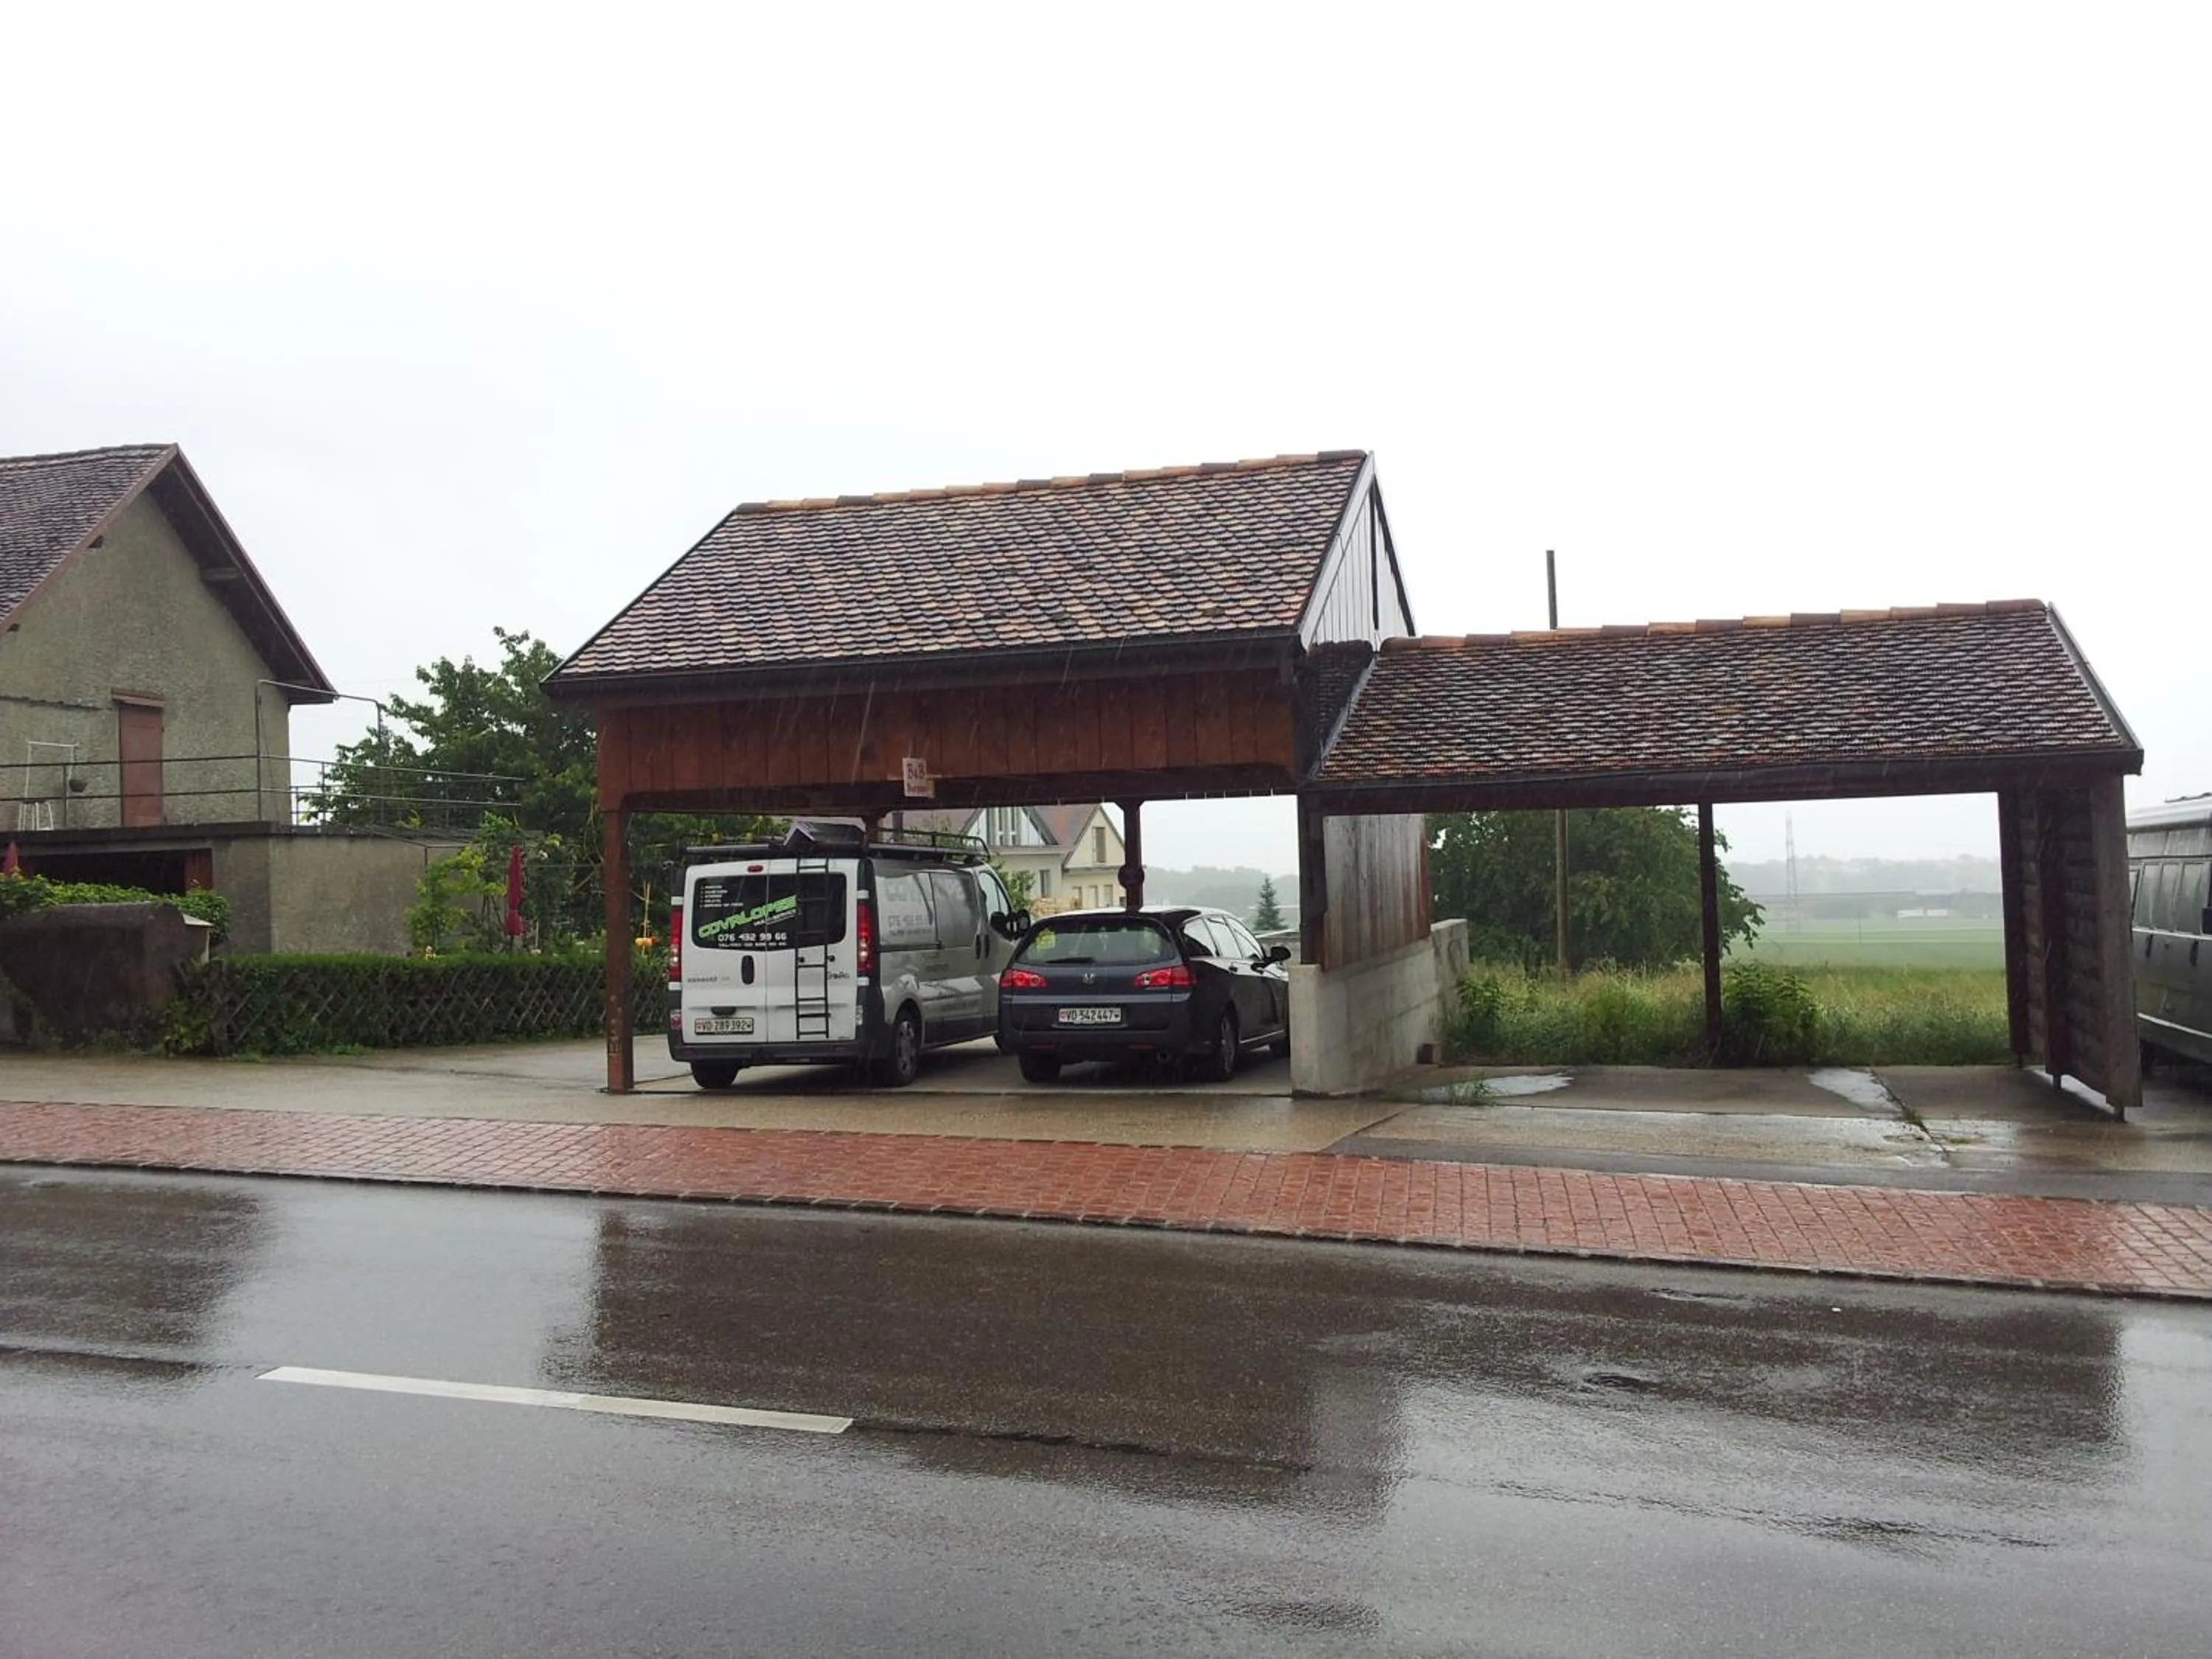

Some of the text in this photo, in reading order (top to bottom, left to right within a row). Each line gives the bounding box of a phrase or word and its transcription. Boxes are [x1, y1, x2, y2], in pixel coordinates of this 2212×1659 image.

[717, 932, 787, 942] 076 432 99 66
